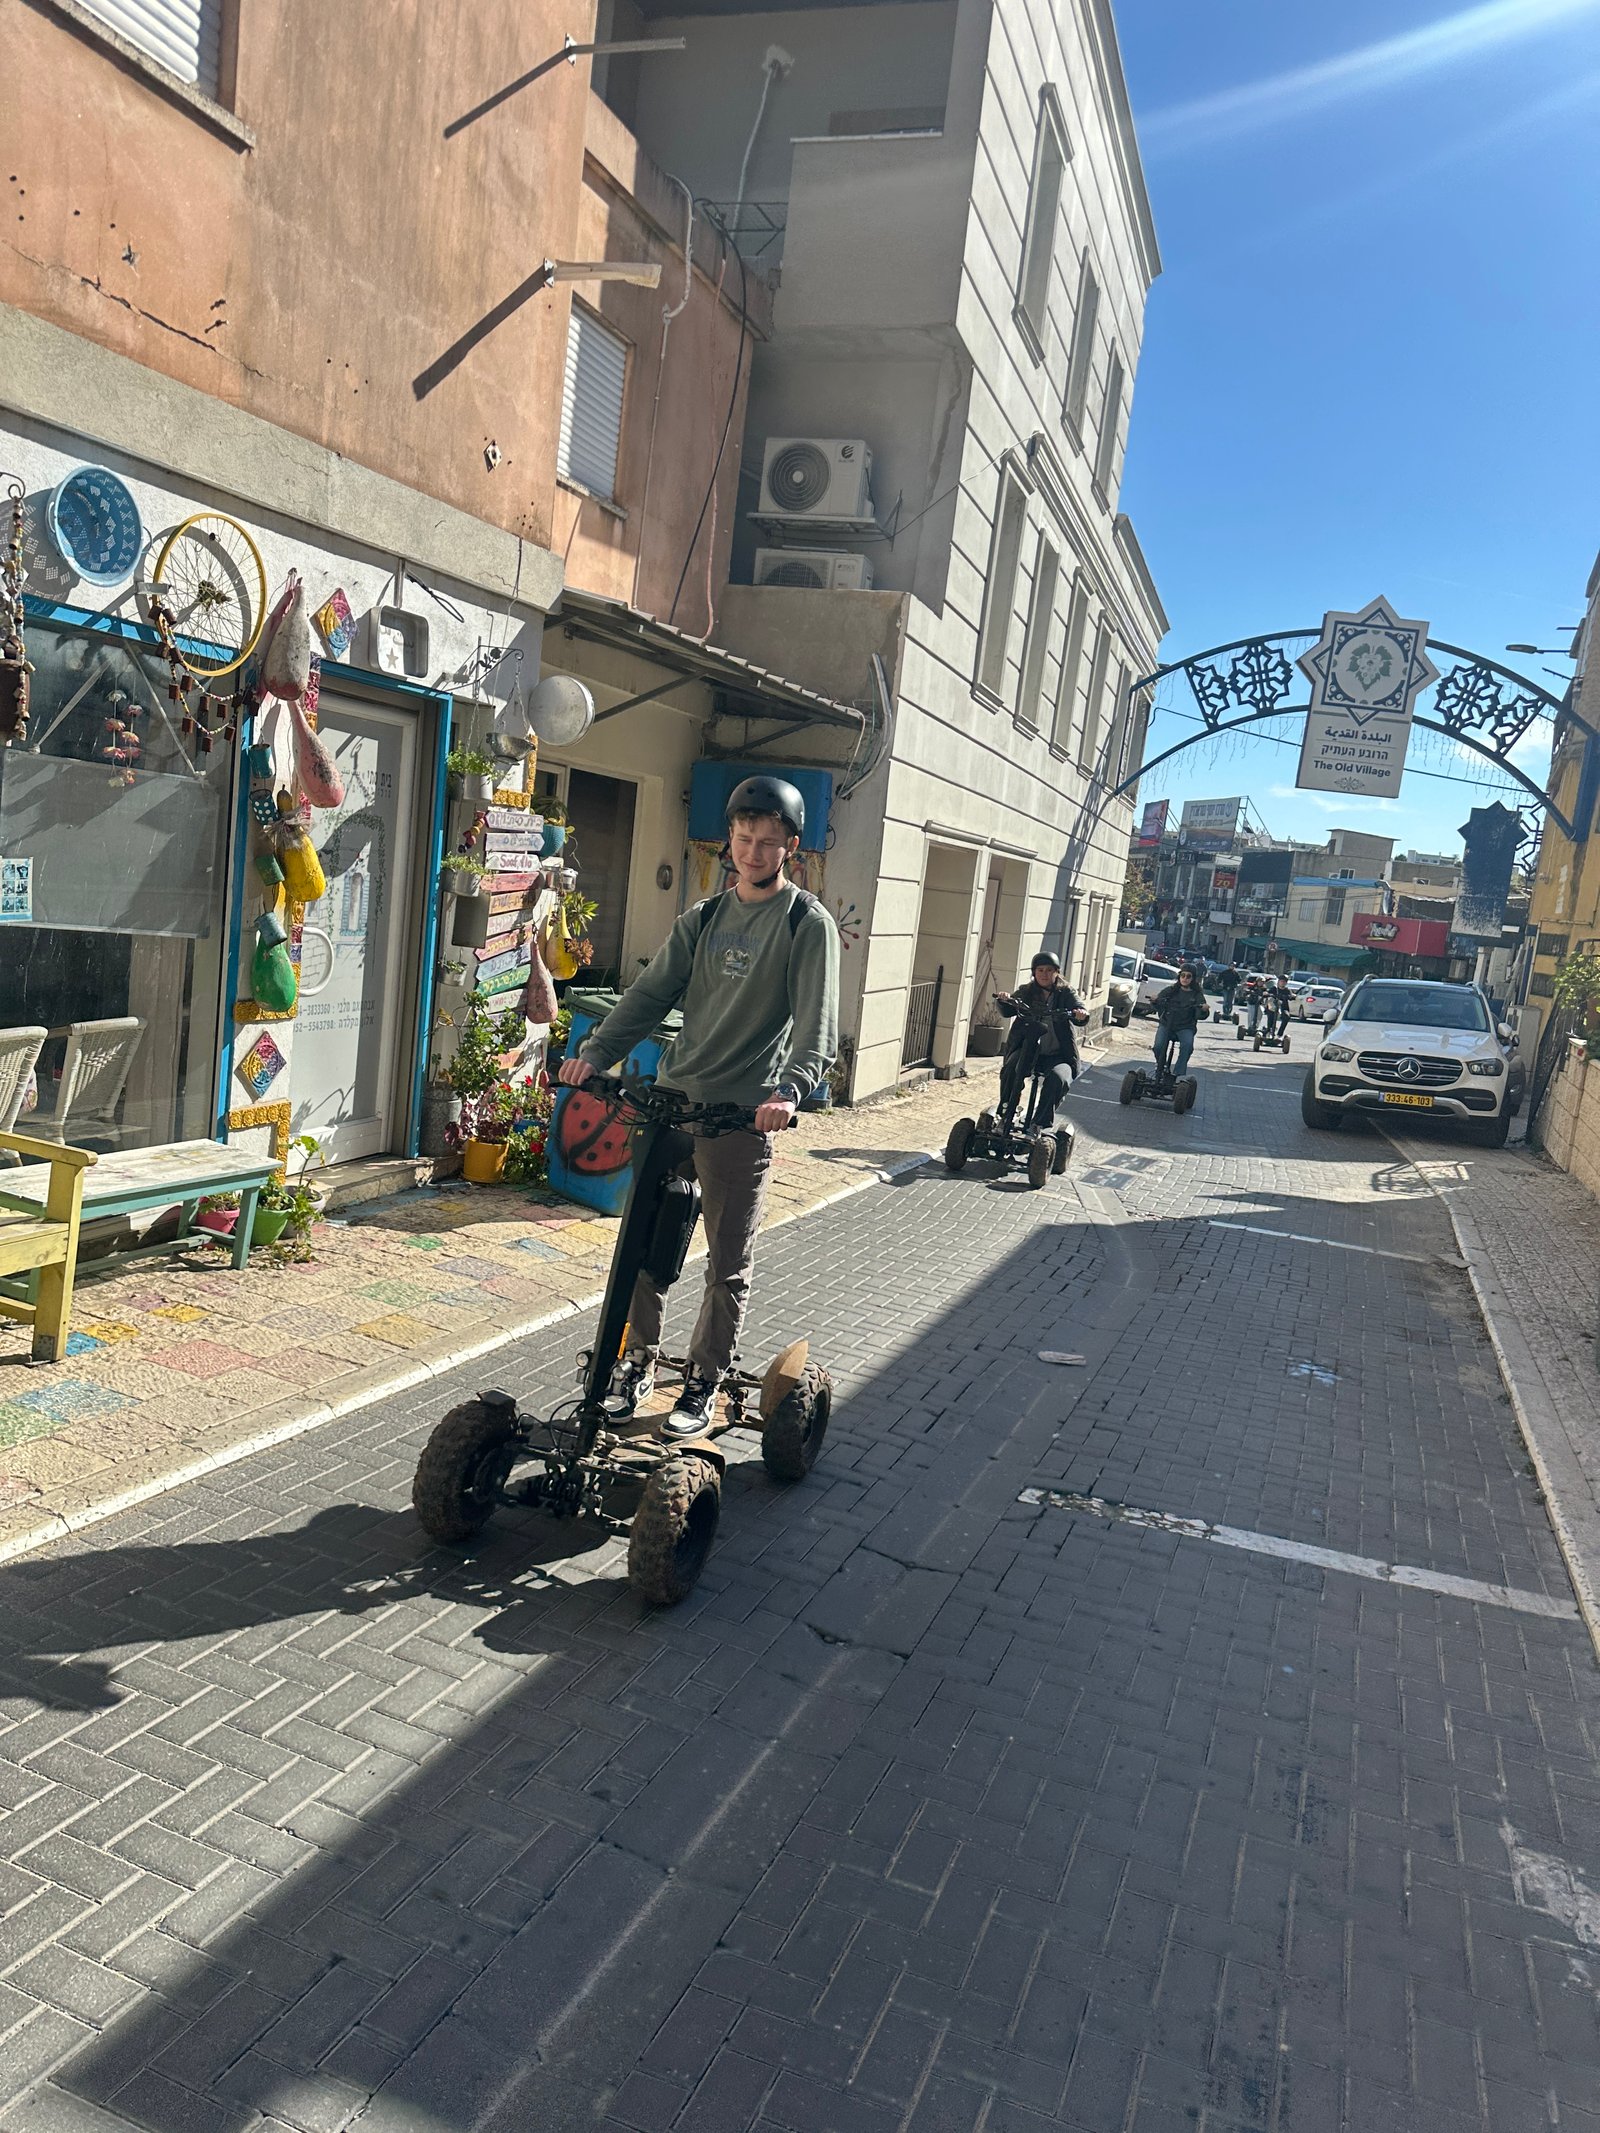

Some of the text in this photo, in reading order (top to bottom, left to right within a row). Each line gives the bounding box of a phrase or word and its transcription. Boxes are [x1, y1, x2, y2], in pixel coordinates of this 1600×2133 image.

[1325, 726, 1392, 745] البلدة القديمة
[1321, 744, 1389, 760] הרובע העתיק
[1314, 759, 1391, 778] The Old Village
